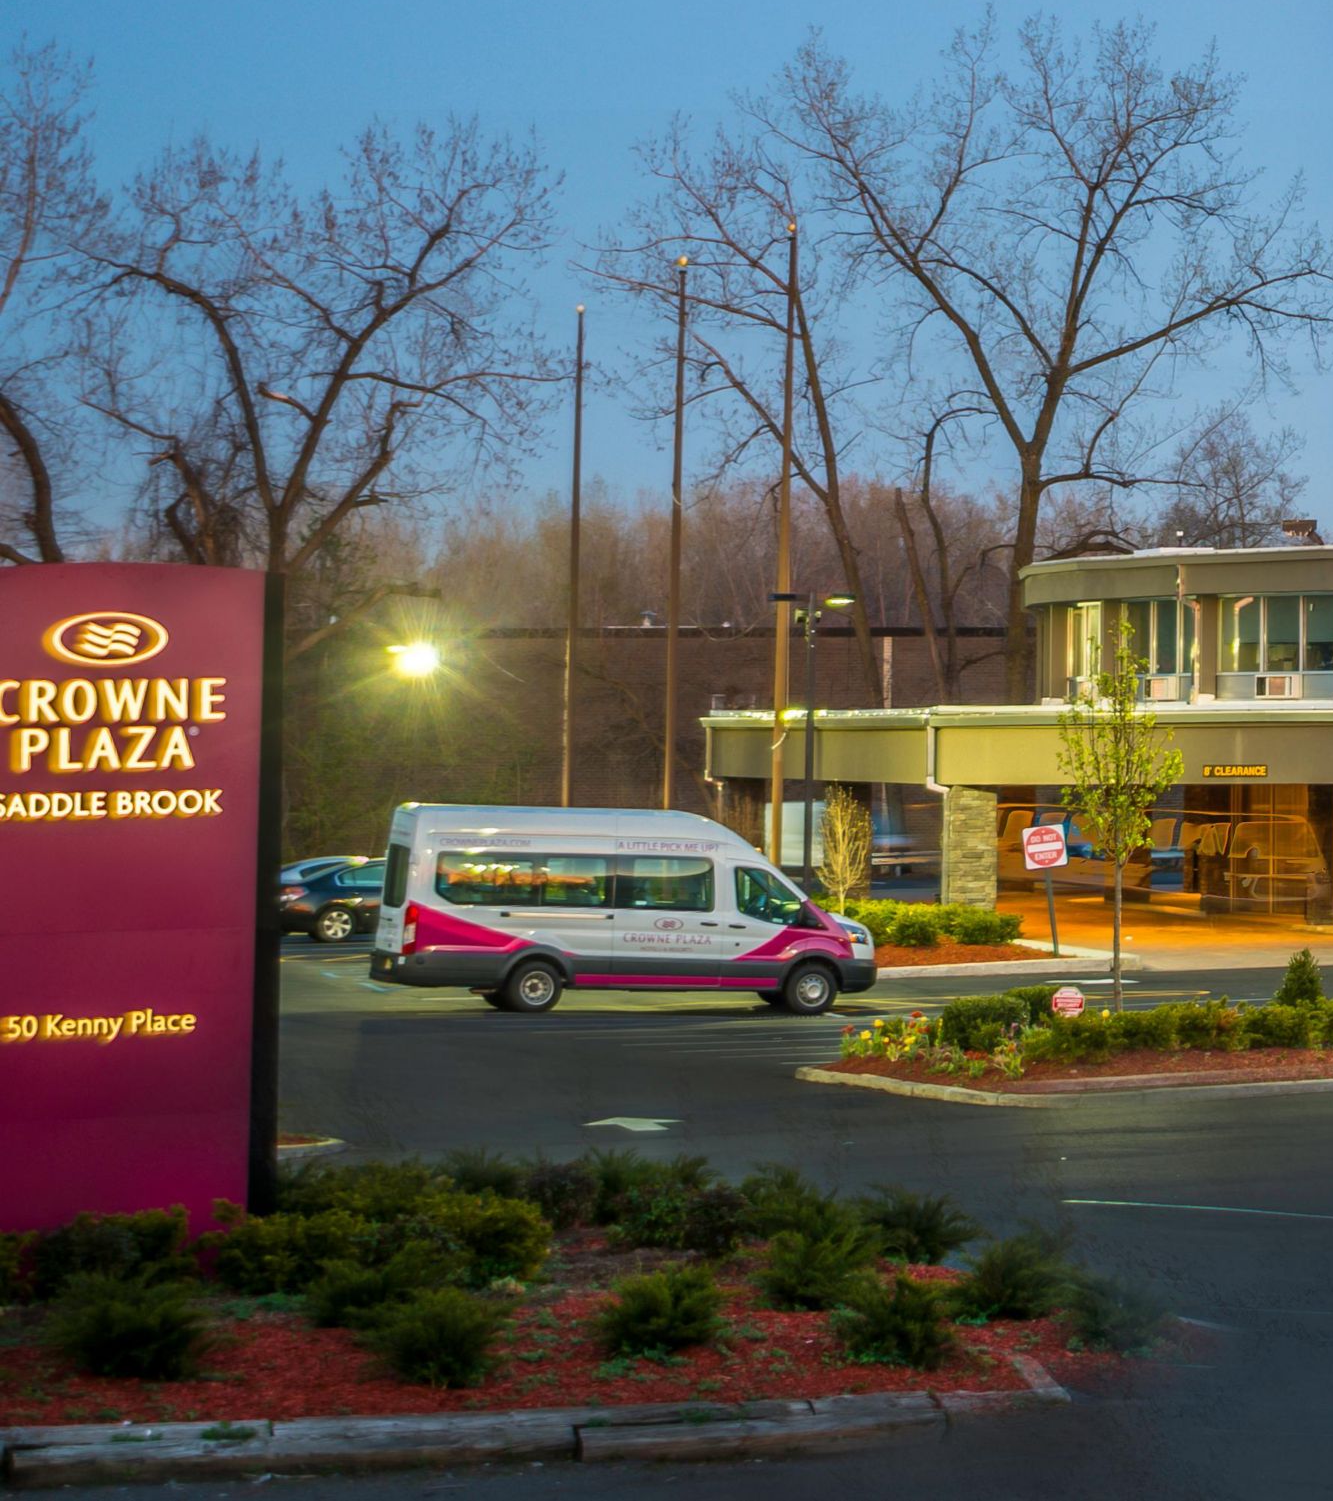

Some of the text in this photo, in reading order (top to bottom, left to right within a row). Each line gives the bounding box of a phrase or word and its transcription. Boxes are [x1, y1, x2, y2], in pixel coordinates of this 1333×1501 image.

[0, 677, 227, 725] CROWNE
[16, 725, 196, 772] PLAZA
[1214, 766, 1267, 776] CLEARANCE
[112, 788, 223, 816] BROOK
[1030, 833, 1057, 843] DO NOT
[660, 842, 681, 851] PICK
[683, 843, 698, 852] ME
[1034, 851, 1058, 861] ENTER
[623, 932, 712, 946] CROWNE PLAZA
[5, 1008, 197, 1043] 50 Kenny Place
